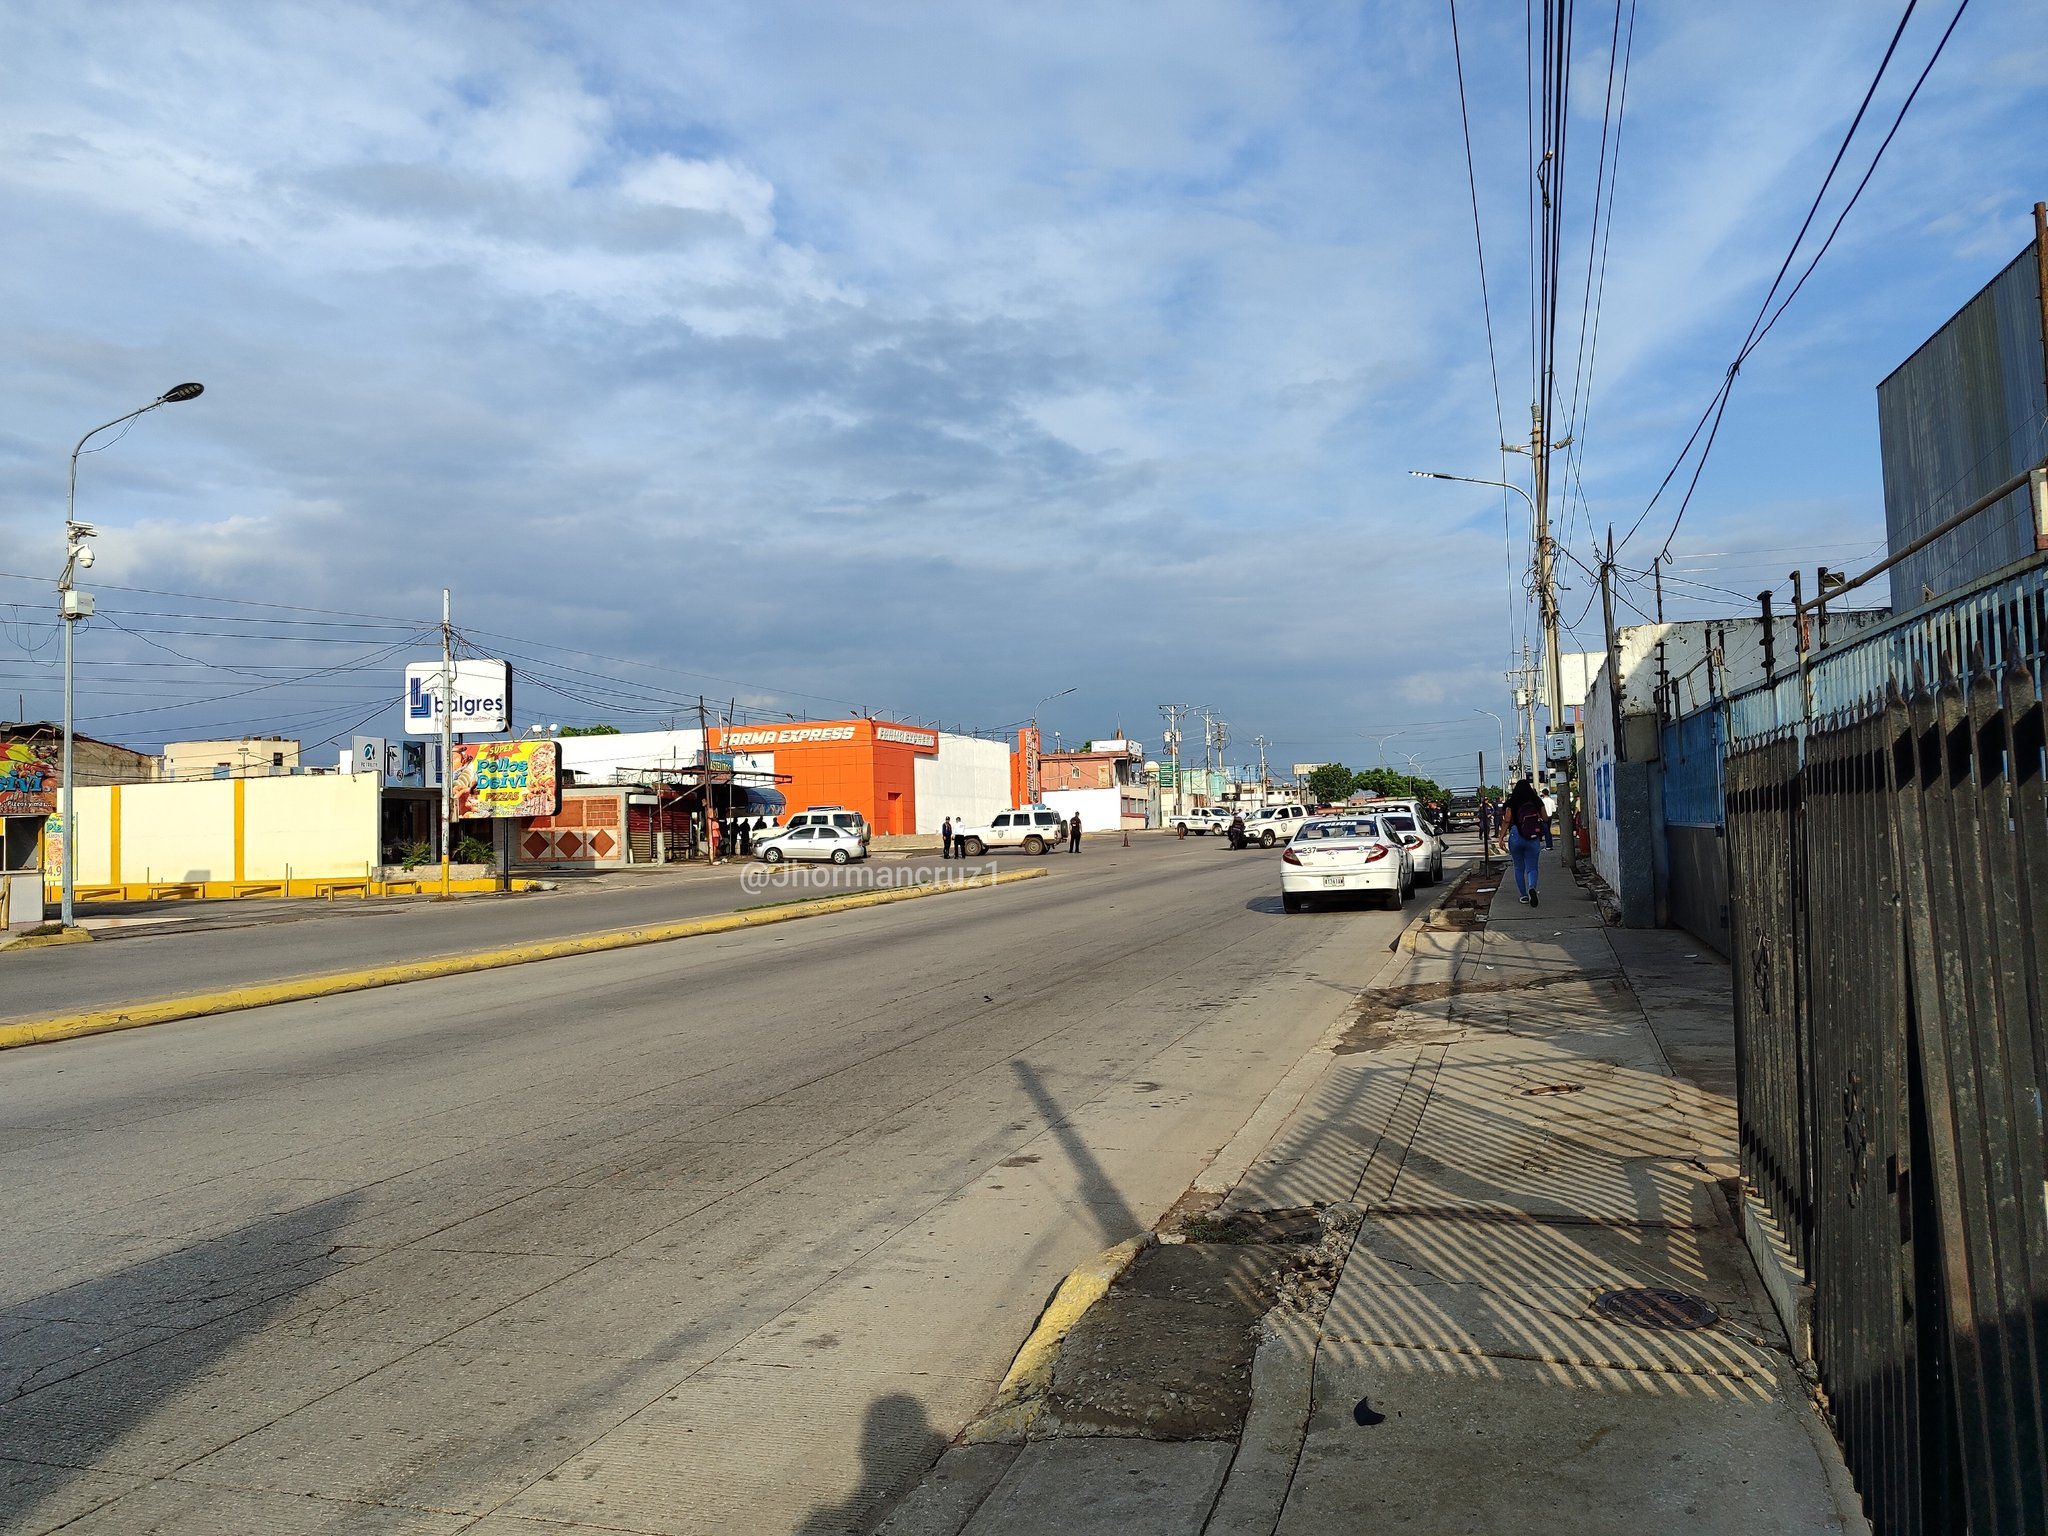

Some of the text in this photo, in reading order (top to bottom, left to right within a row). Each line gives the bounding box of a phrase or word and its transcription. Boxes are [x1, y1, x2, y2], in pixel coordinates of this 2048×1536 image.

[434, 695, 503, 716] balgres
[719, 726, 856, 747] FARMA EXPRESS
[489, 743, 514, 755] SUPER
[476, 757, 528, 774] Pollos
[476, 771, 528, 789] Deivi
[485, 791, 520, 802] PIZZAS
[1302, 846, 1317, 855] 237
